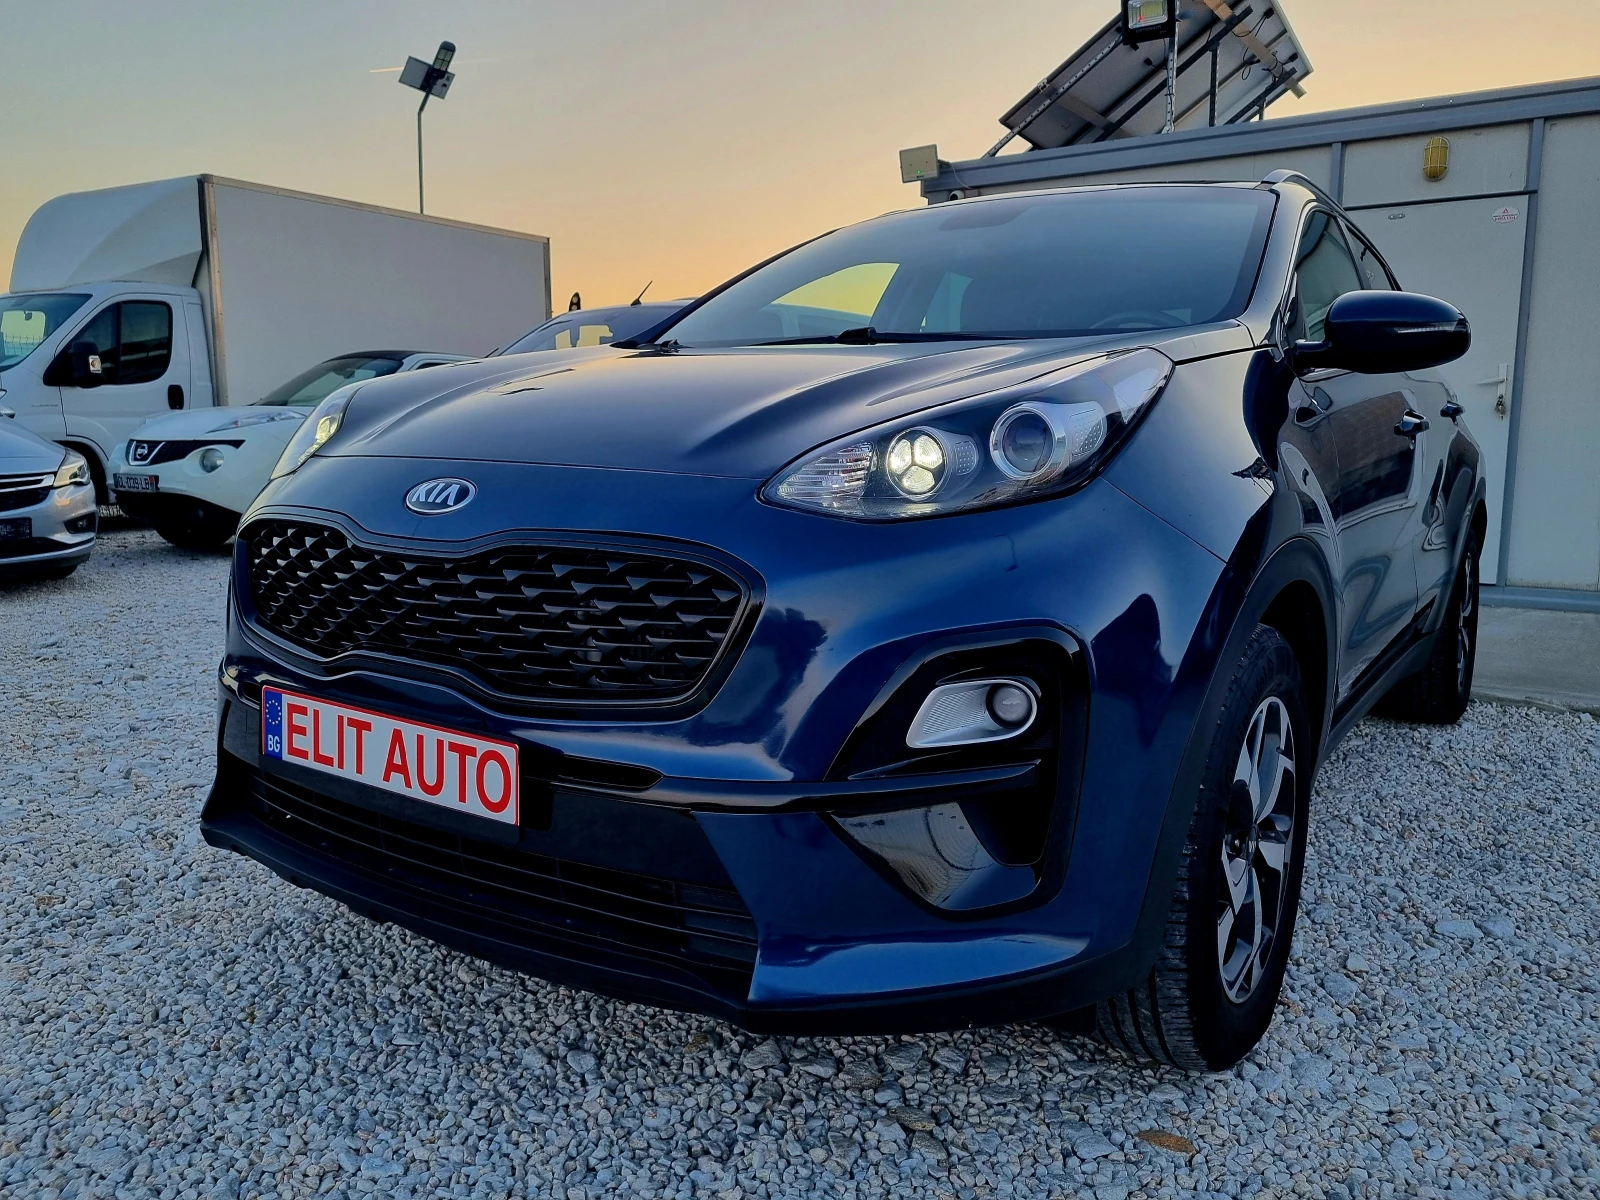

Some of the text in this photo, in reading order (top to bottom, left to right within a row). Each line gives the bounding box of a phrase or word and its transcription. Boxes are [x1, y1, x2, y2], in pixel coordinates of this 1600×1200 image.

[411, 482, 461, 506] KIA
[267, 734, 281, 753] BG
[286, 702, 512, 814] ELIT AUTO
